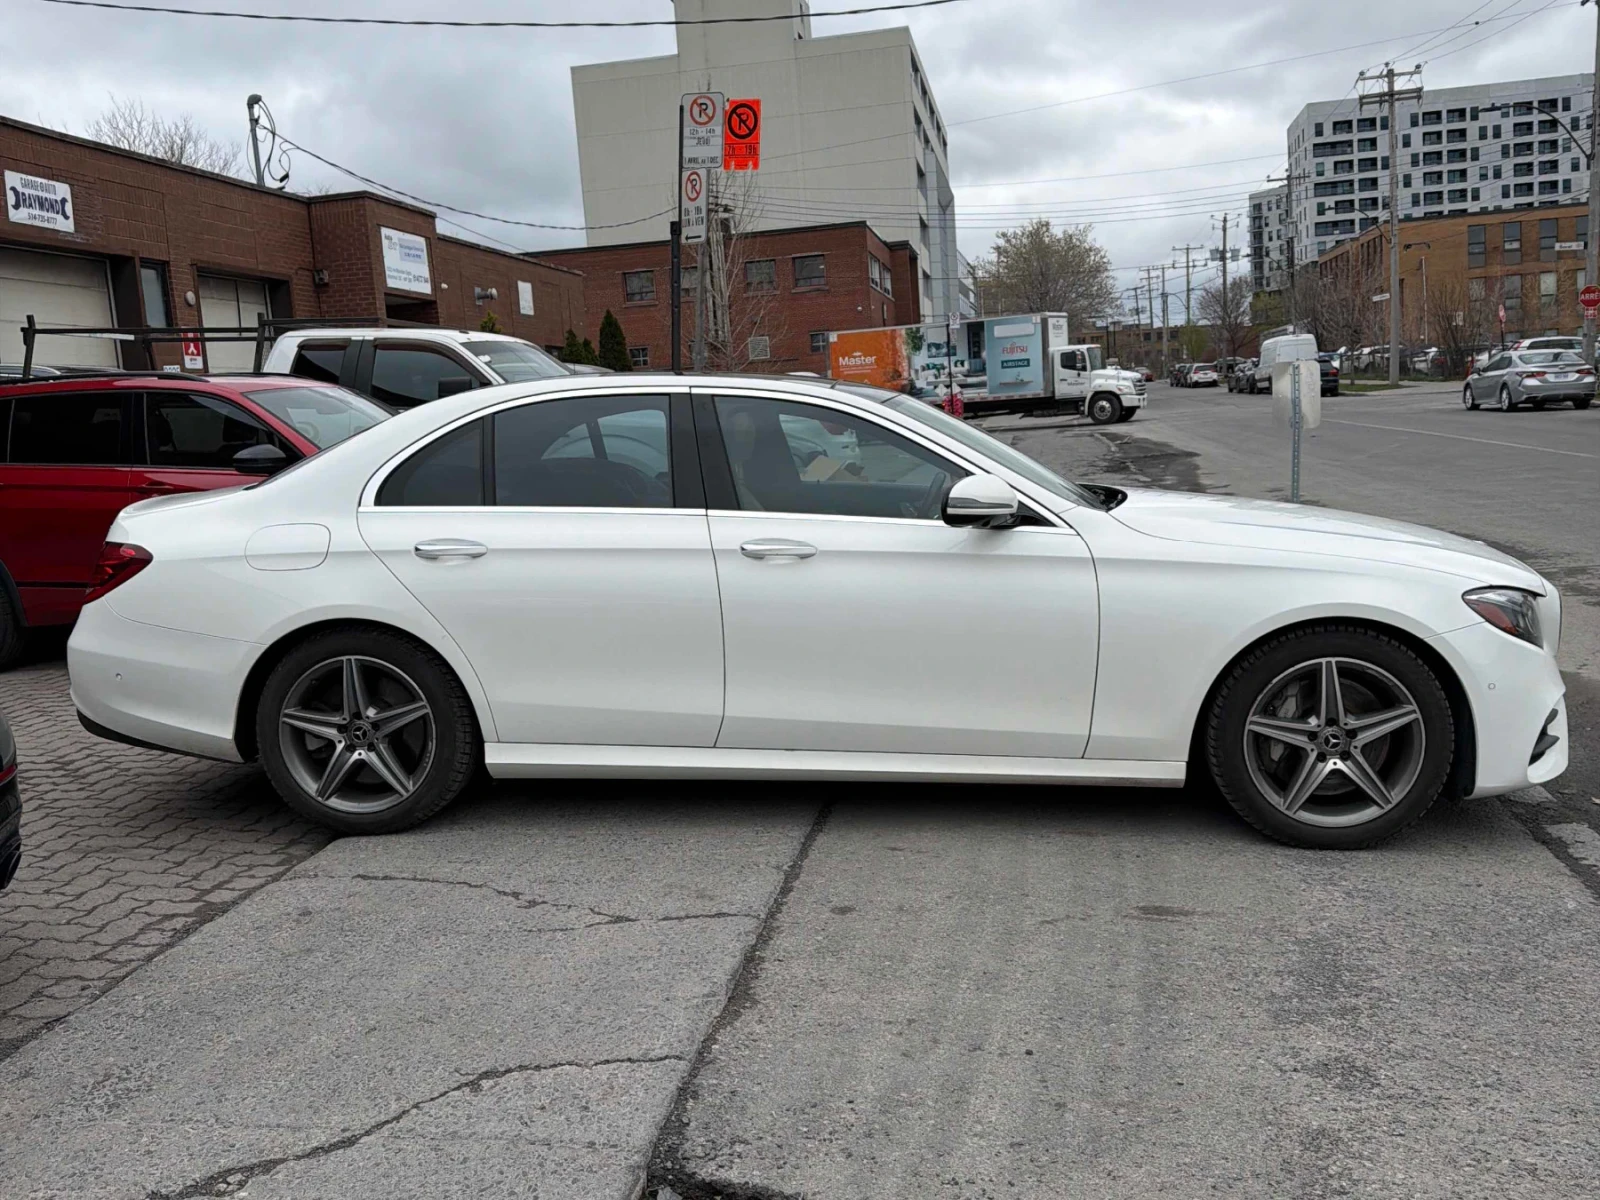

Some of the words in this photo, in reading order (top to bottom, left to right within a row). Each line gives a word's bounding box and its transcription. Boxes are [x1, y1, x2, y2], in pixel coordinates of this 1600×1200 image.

[688, 156, 700, 164] AVRIL
[20, 176, 40, 193] GARAGE
[21, 191, 60, 215] RAYMOND
[1580, 291, 1600, 300] ARRÊ
[1002, 344, 1028, 355] FUJITSU
[839, 355, 877, 366] Master
